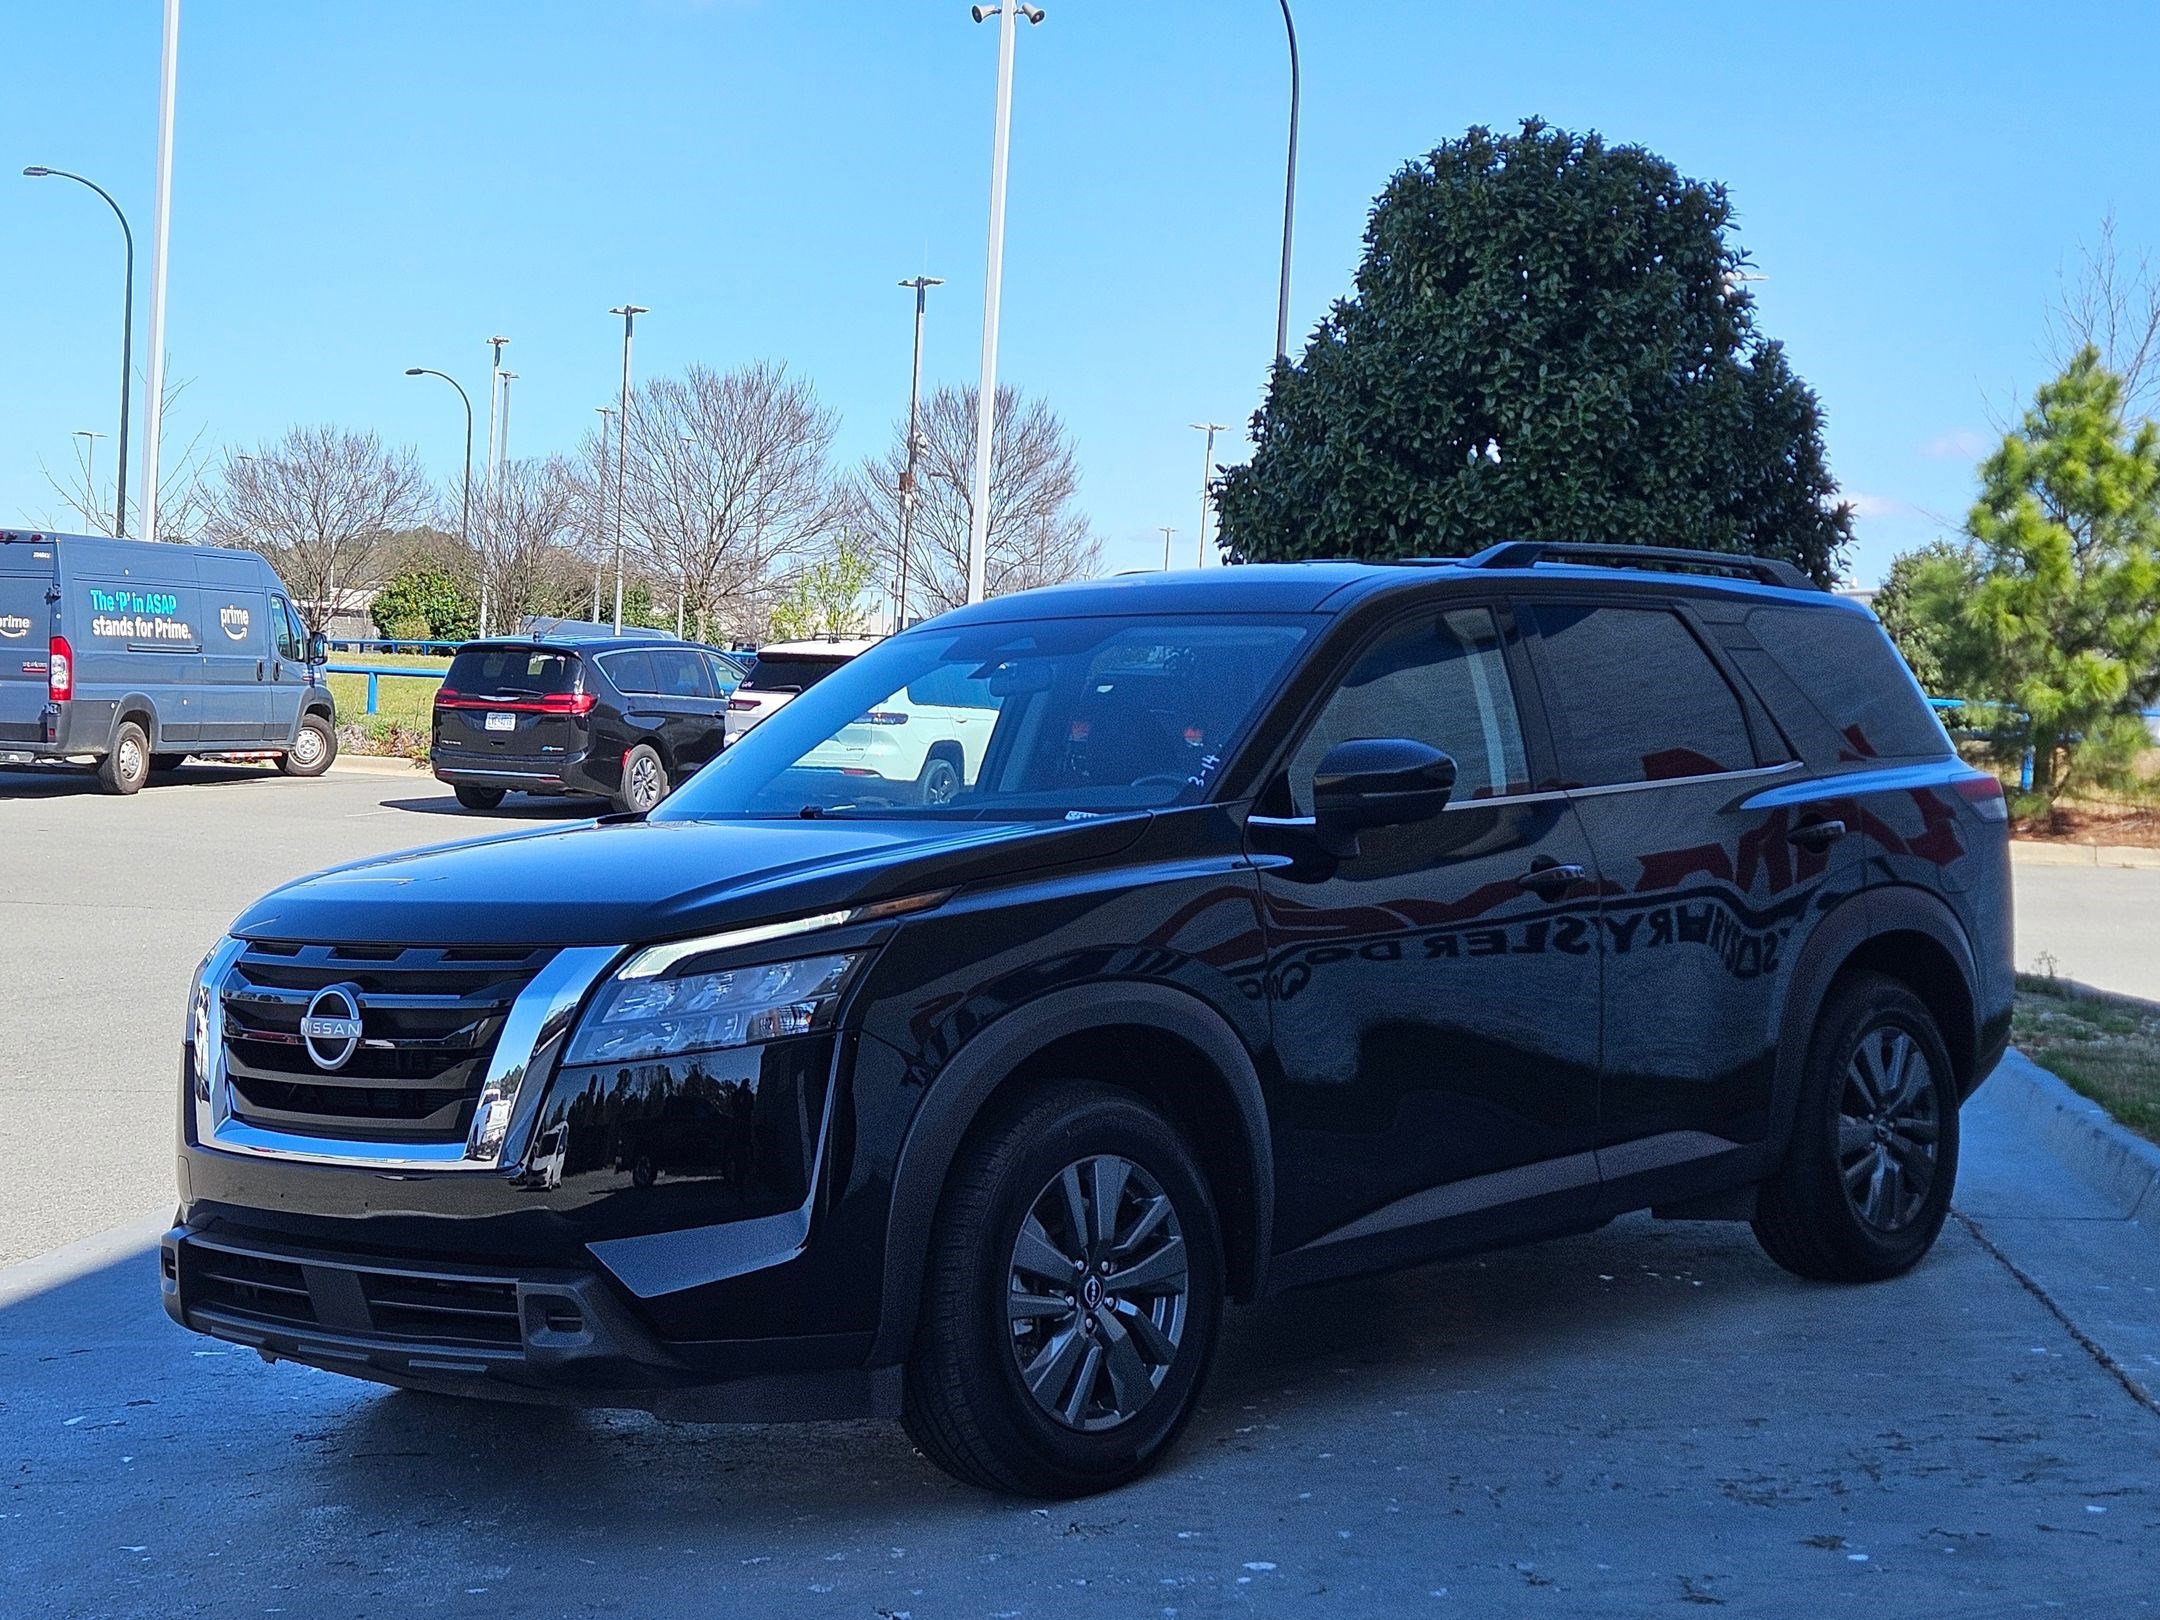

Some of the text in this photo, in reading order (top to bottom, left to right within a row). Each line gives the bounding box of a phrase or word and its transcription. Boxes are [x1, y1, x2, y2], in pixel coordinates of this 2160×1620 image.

[90, 589, 115, 612] The
[132, 592, 144, 613] in
[146, 593, 177, 615] ASAP
[220, 604, 249, 627] prime
[92, 616, 134, 637] stands
[134, 616, 154, 639] for
[1187, 754, 1220, 787] 3-14
[302, 1021, 360, 1035] NISSAN
